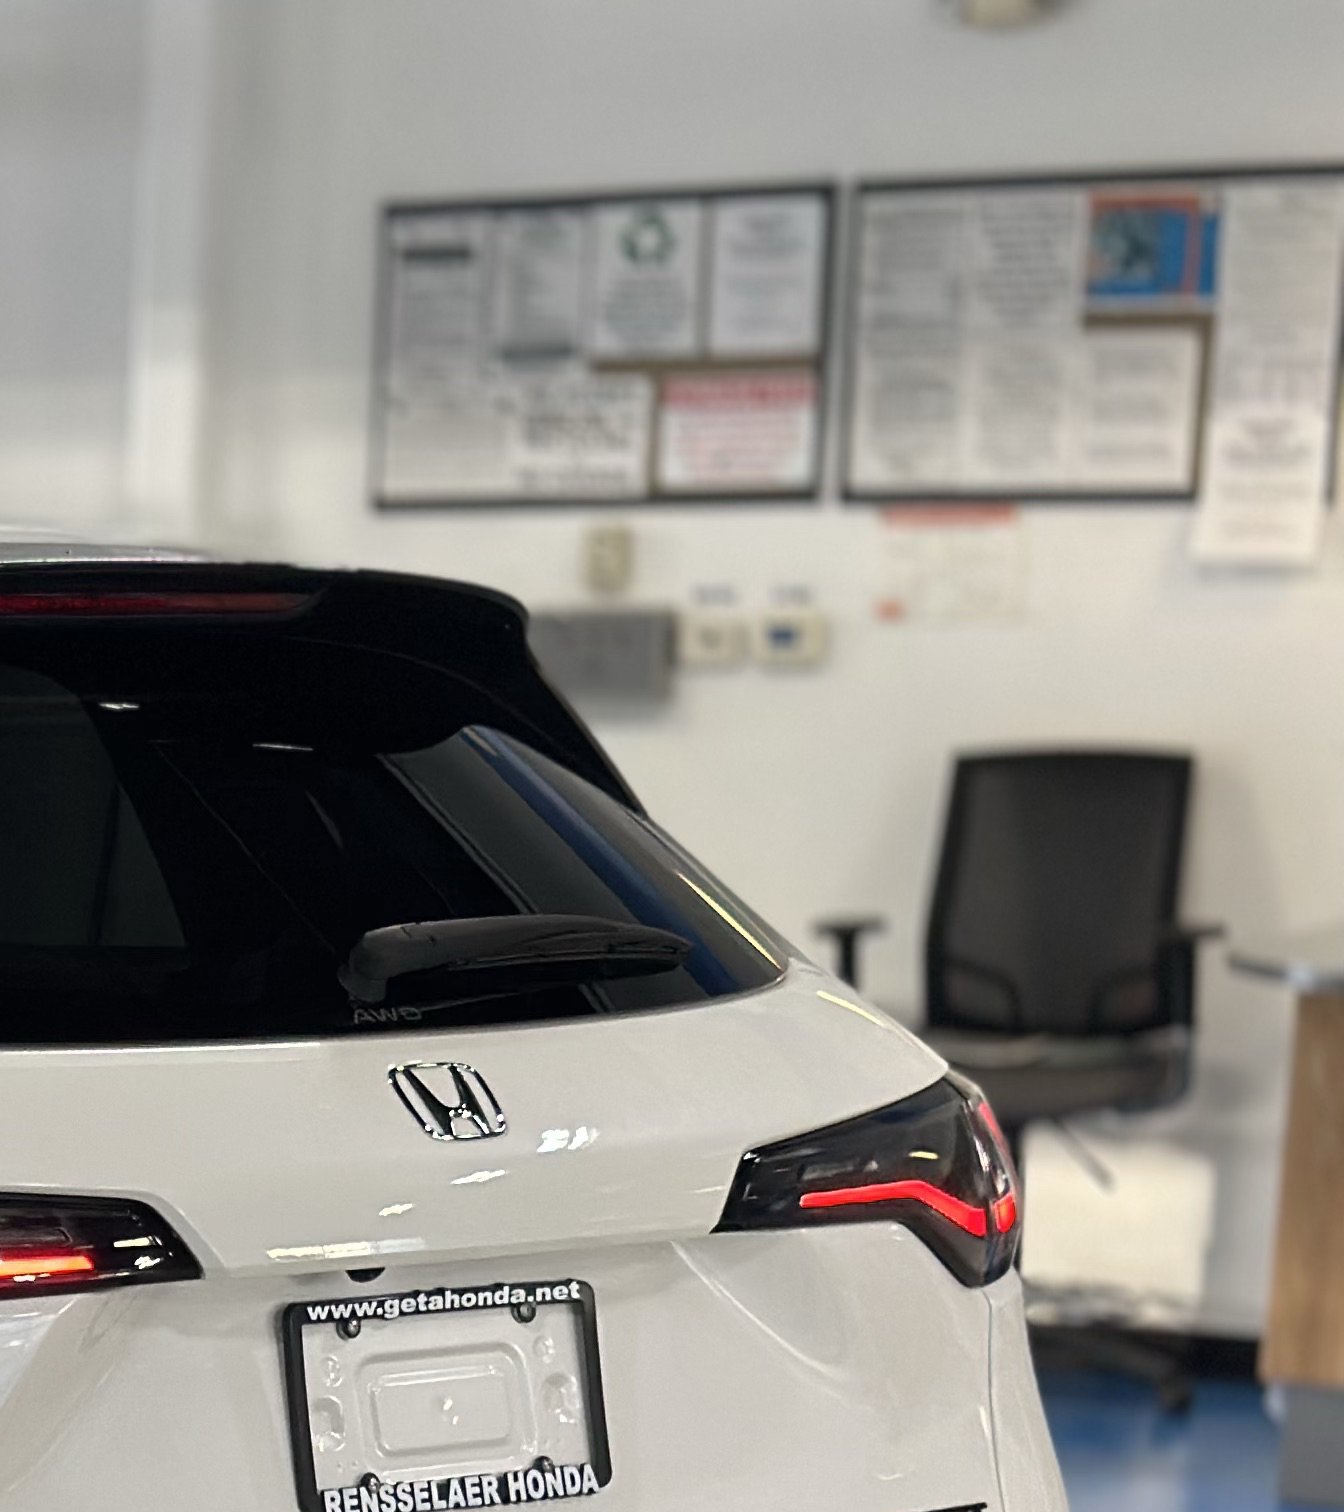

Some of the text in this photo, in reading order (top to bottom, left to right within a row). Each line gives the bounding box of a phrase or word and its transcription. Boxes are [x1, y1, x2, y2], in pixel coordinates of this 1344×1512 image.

[353, 1007, 423, 1025] AWD
[307, 1281, 581, 1321] www.getahonda.net
[509, 1464, 601, 1503] HONDA
